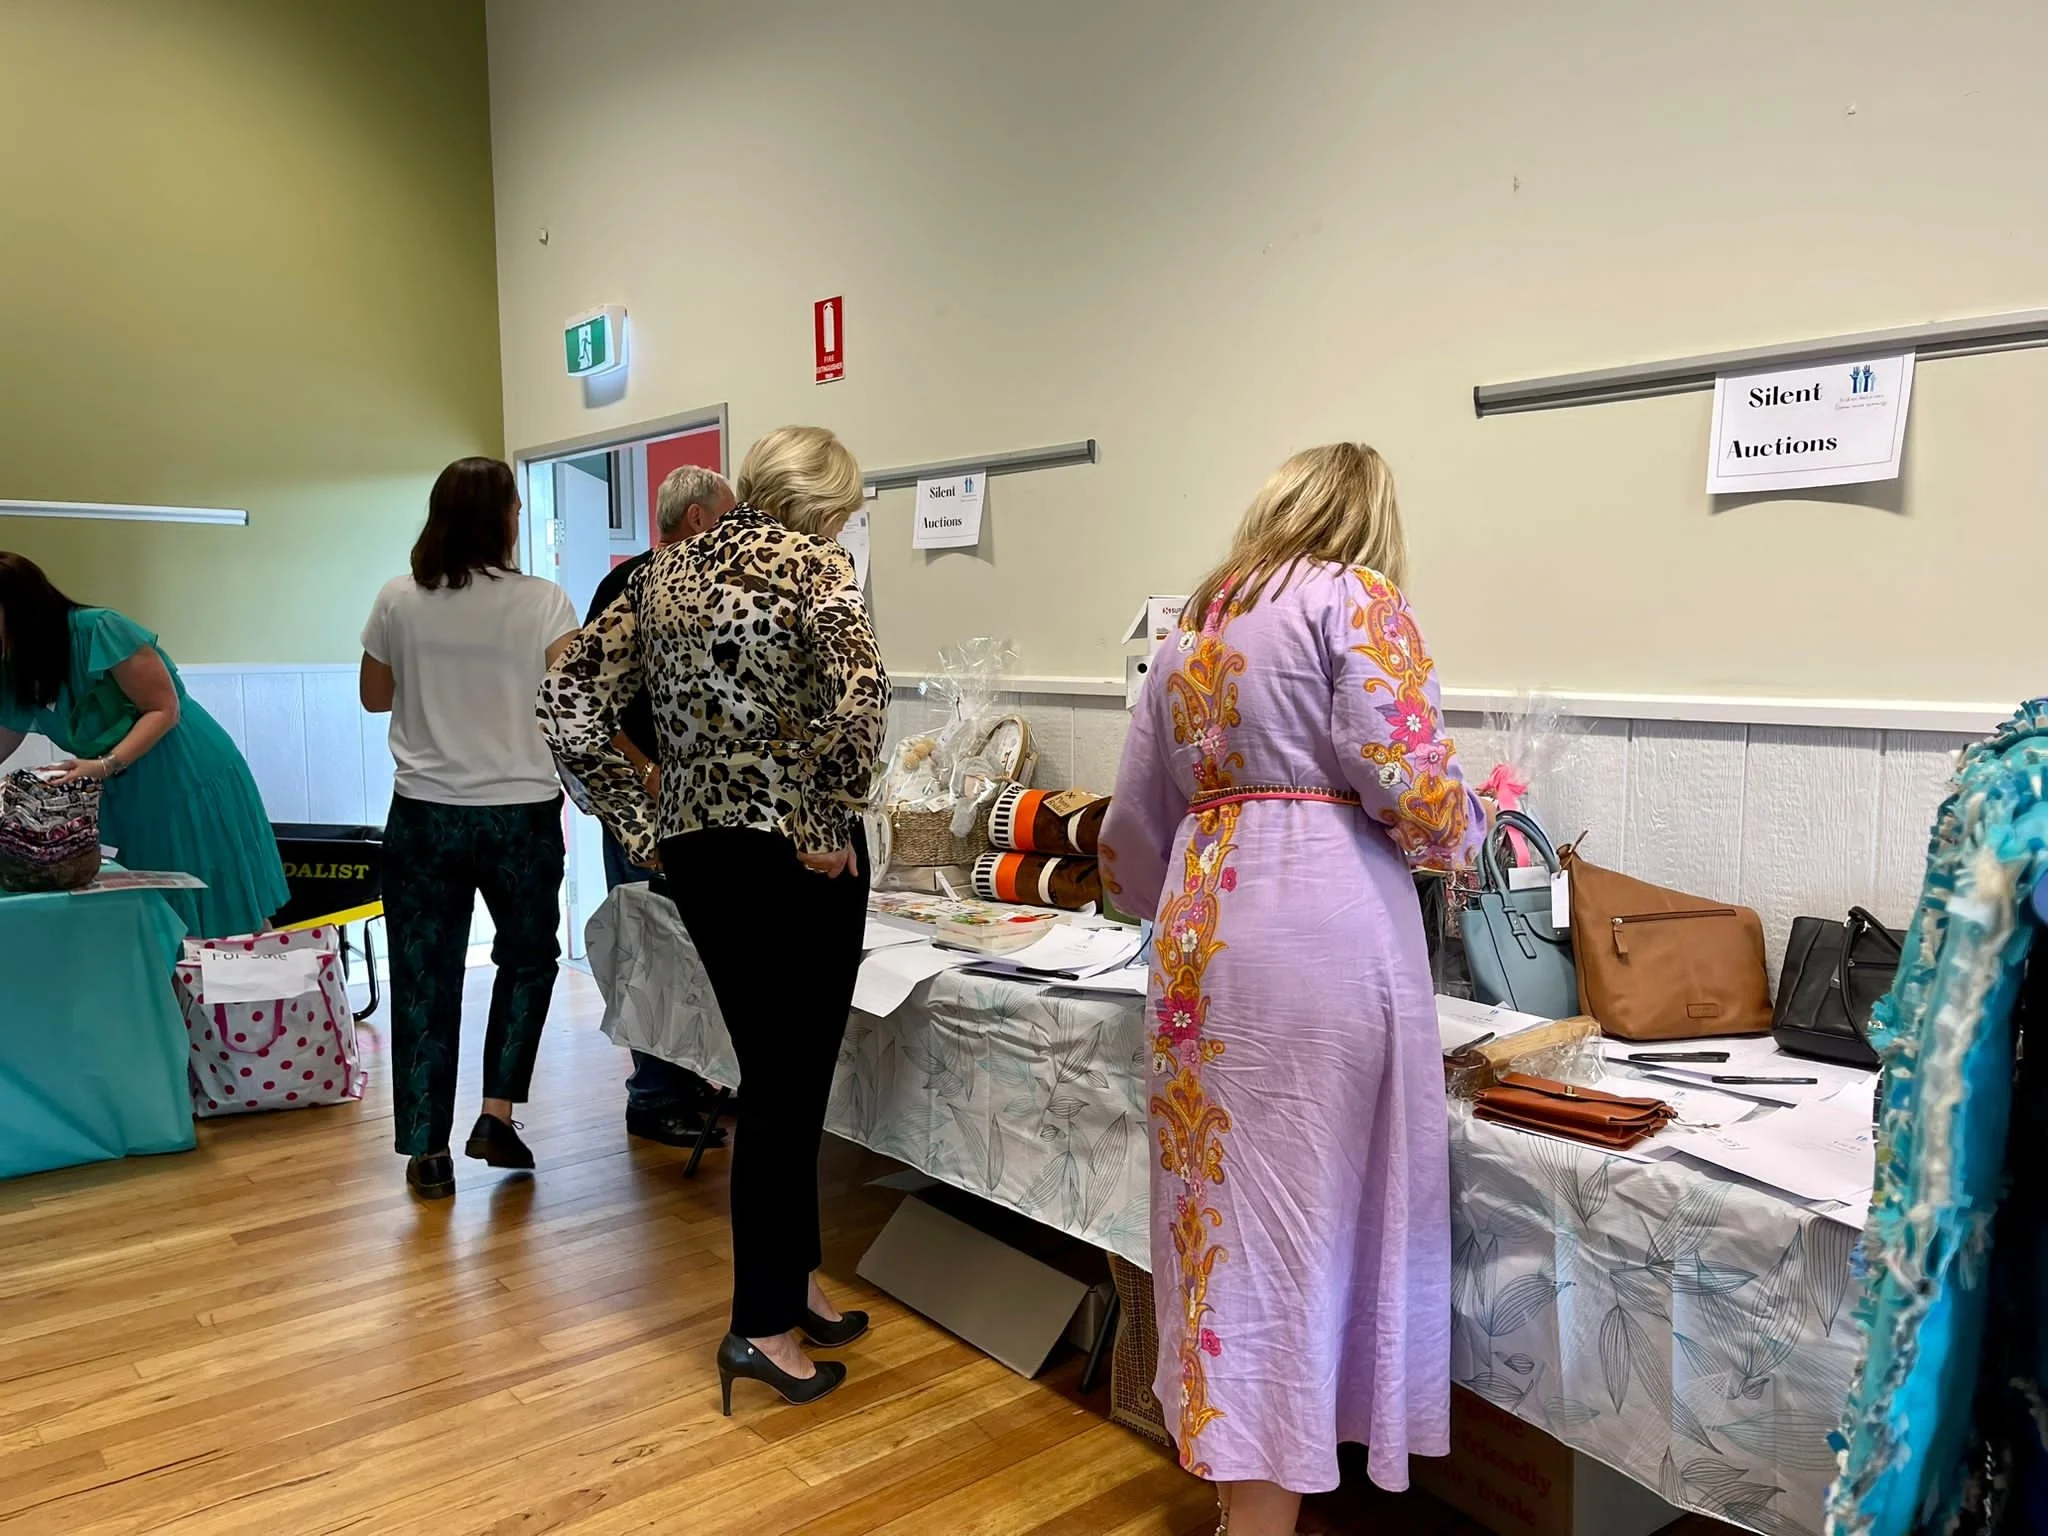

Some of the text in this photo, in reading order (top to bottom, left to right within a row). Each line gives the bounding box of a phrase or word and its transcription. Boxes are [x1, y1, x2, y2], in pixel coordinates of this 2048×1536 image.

[1748, 383, 1823, 408] Silent
[1726, 436, 1838, 459] Auctions
[929, 485, 956, 499] Silent
[921, 516, 962, 529] Auctions
